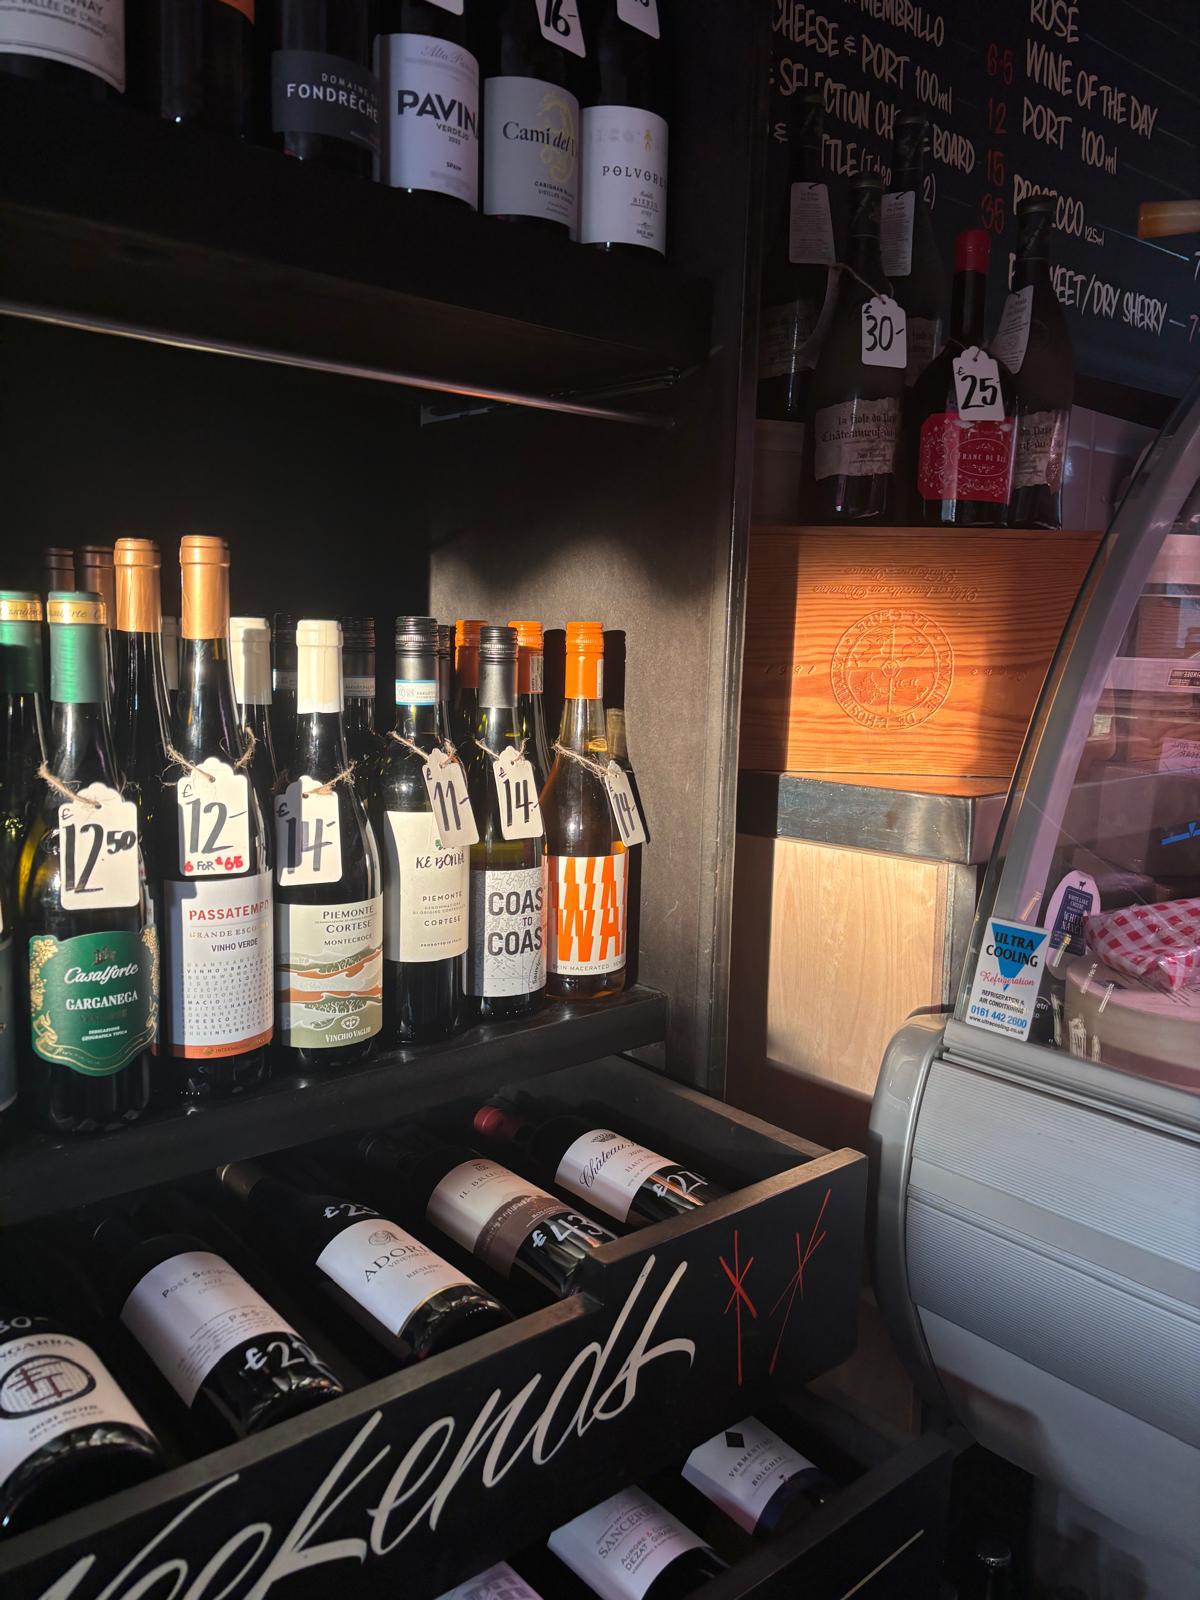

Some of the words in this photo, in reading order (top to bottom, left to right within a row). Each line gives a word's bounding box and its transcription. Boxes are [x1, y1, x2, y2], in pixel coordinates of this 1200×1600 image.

[861, 33, 911, 90] PORT
[914, 65, 953, 115] 100ml
[779, 57, 870, 129] SECTION
[1026, 37, 1073, 97] WINE
[1076, 69, 1099, 111] OF
[1099, 84, 1127, 125] THE
[1130, 95, 1159, 140] DAY
[1022, 96, 1073, 151] PORT
[1080, 126, 1118, 175] 100ml
[821, 133, 859, 177] TTLE
[932, 122, 975, 175] BOARD
[1122, 290, 1168, 337] SHERRY
[184, 861, 194, 872] 6
[196, 861, 215, 871] FOR
[416, 855, 432, 869] KE
[422, 891, 462, 902] PIEMONTE
[322, 905, 374, 920] PIEMONTE
[424, 916, 462, 927] CORTESE
[522, 916, 533, 927] TO
[326, 919, 372, 934] CORTESE
[211, 943, 236, 953] VINHO
[237, 936, 258, 949] VERDE
[324, 934, 373, 946] MONTECROCE
[995, 931, 1035, 949] ULTRA
[985, 944, 1039, 968] COOLING
[64, 963, 139, 985] Casalforte
[979, 970, 1036, 987] Refrigeration
[66, 990, 138, 1011] GARGANEGA
[981, 989, 1018, 1004] REFRIGERATION
[970, 1004, 990, 1019] 0161
[991, 1009, 1006, 1023] 442
[979, 997, 988, 1005] AIR
[988, 999, 1025, 1015] CONDITIONING
